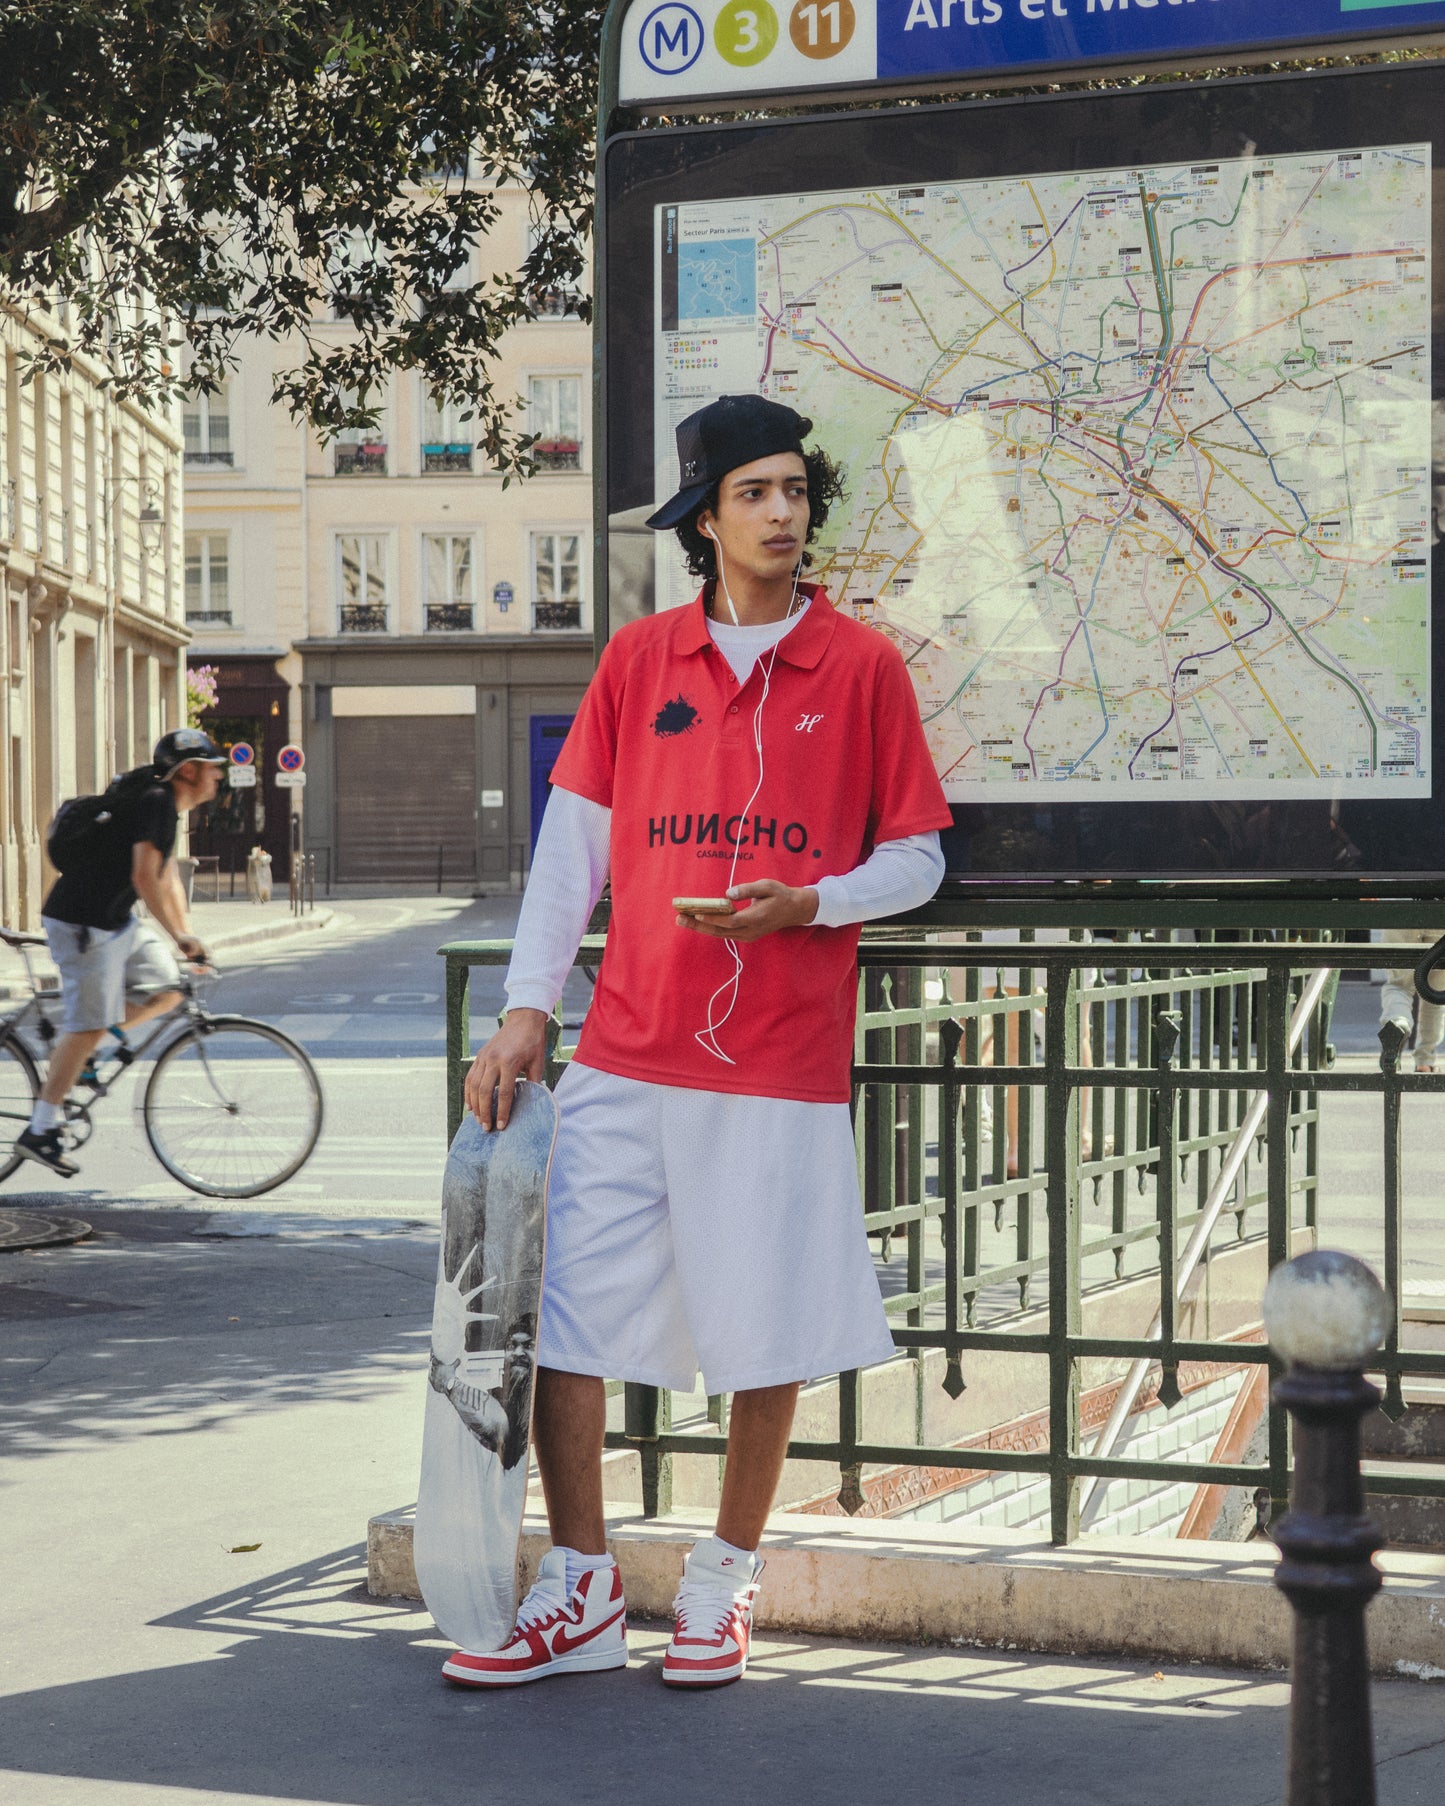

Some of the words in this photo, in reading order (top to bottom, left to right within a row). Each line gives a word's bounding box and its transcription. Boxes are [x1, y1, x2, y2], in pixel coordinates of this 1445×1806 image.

[655, 18, 688, 59] M
[733, 9, 759, 53] 3
[798, 1, 840, 46] 11
[903, 0, 1003, 31] Arts
[696, 849, 754, 861] CASABLANCA
